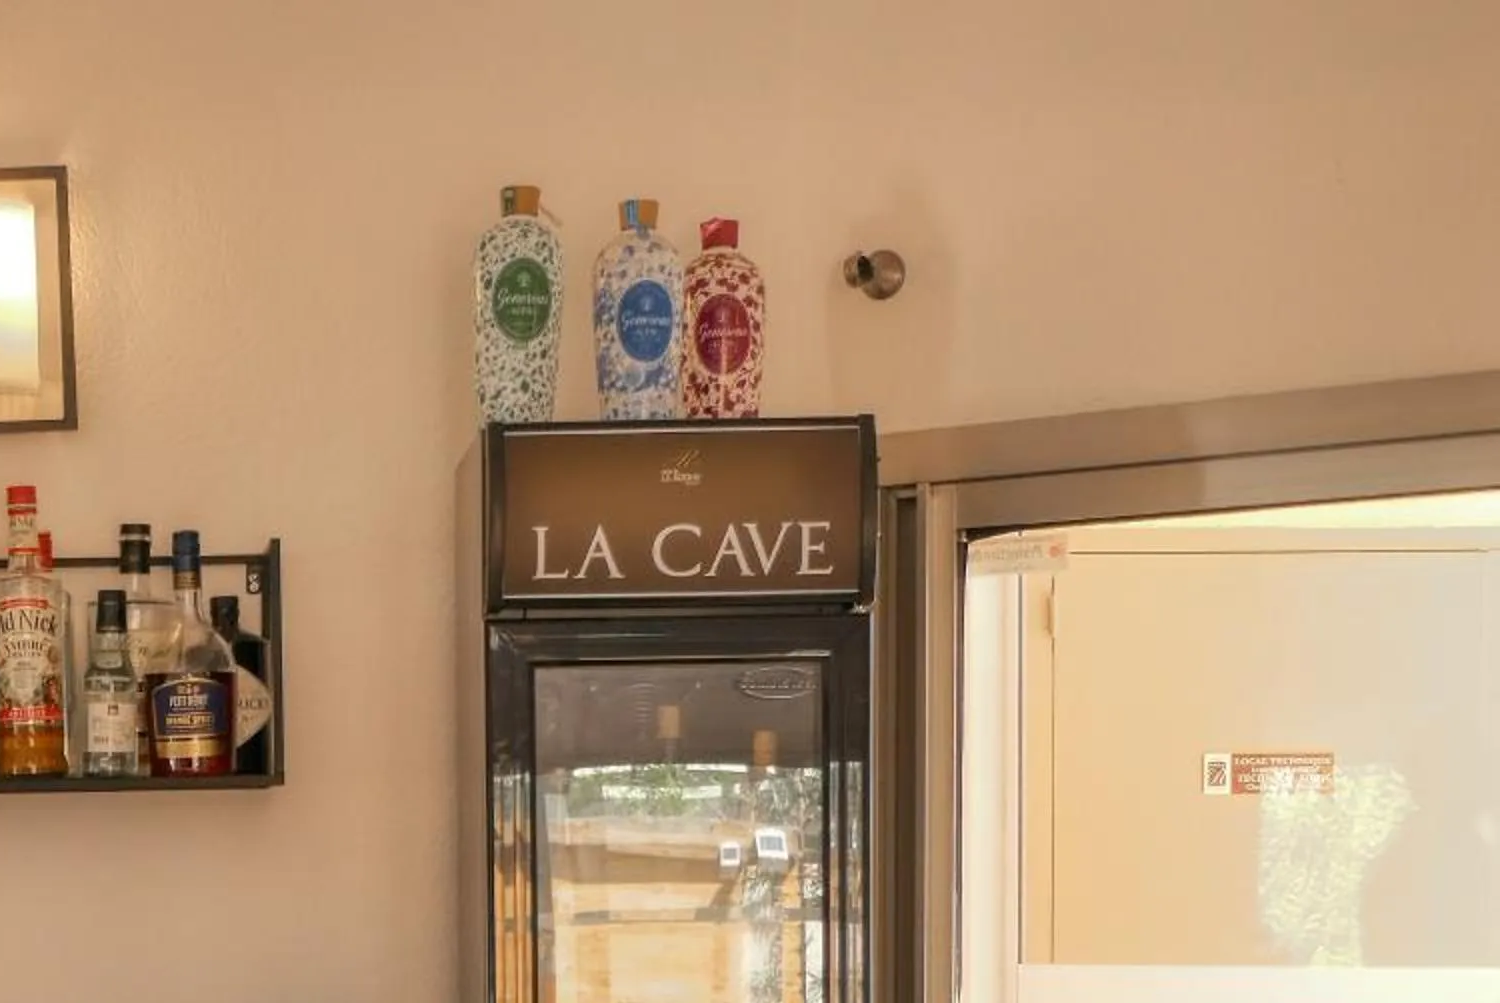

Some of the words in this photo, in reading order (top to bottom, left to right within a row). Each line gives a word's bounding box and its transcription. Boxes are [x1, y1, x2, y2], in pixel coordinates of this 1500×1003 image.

[531, 524, 625, 581] LA
[651, 520, 834, 578] CAVE
[19, 609, 57, 636] Nick
